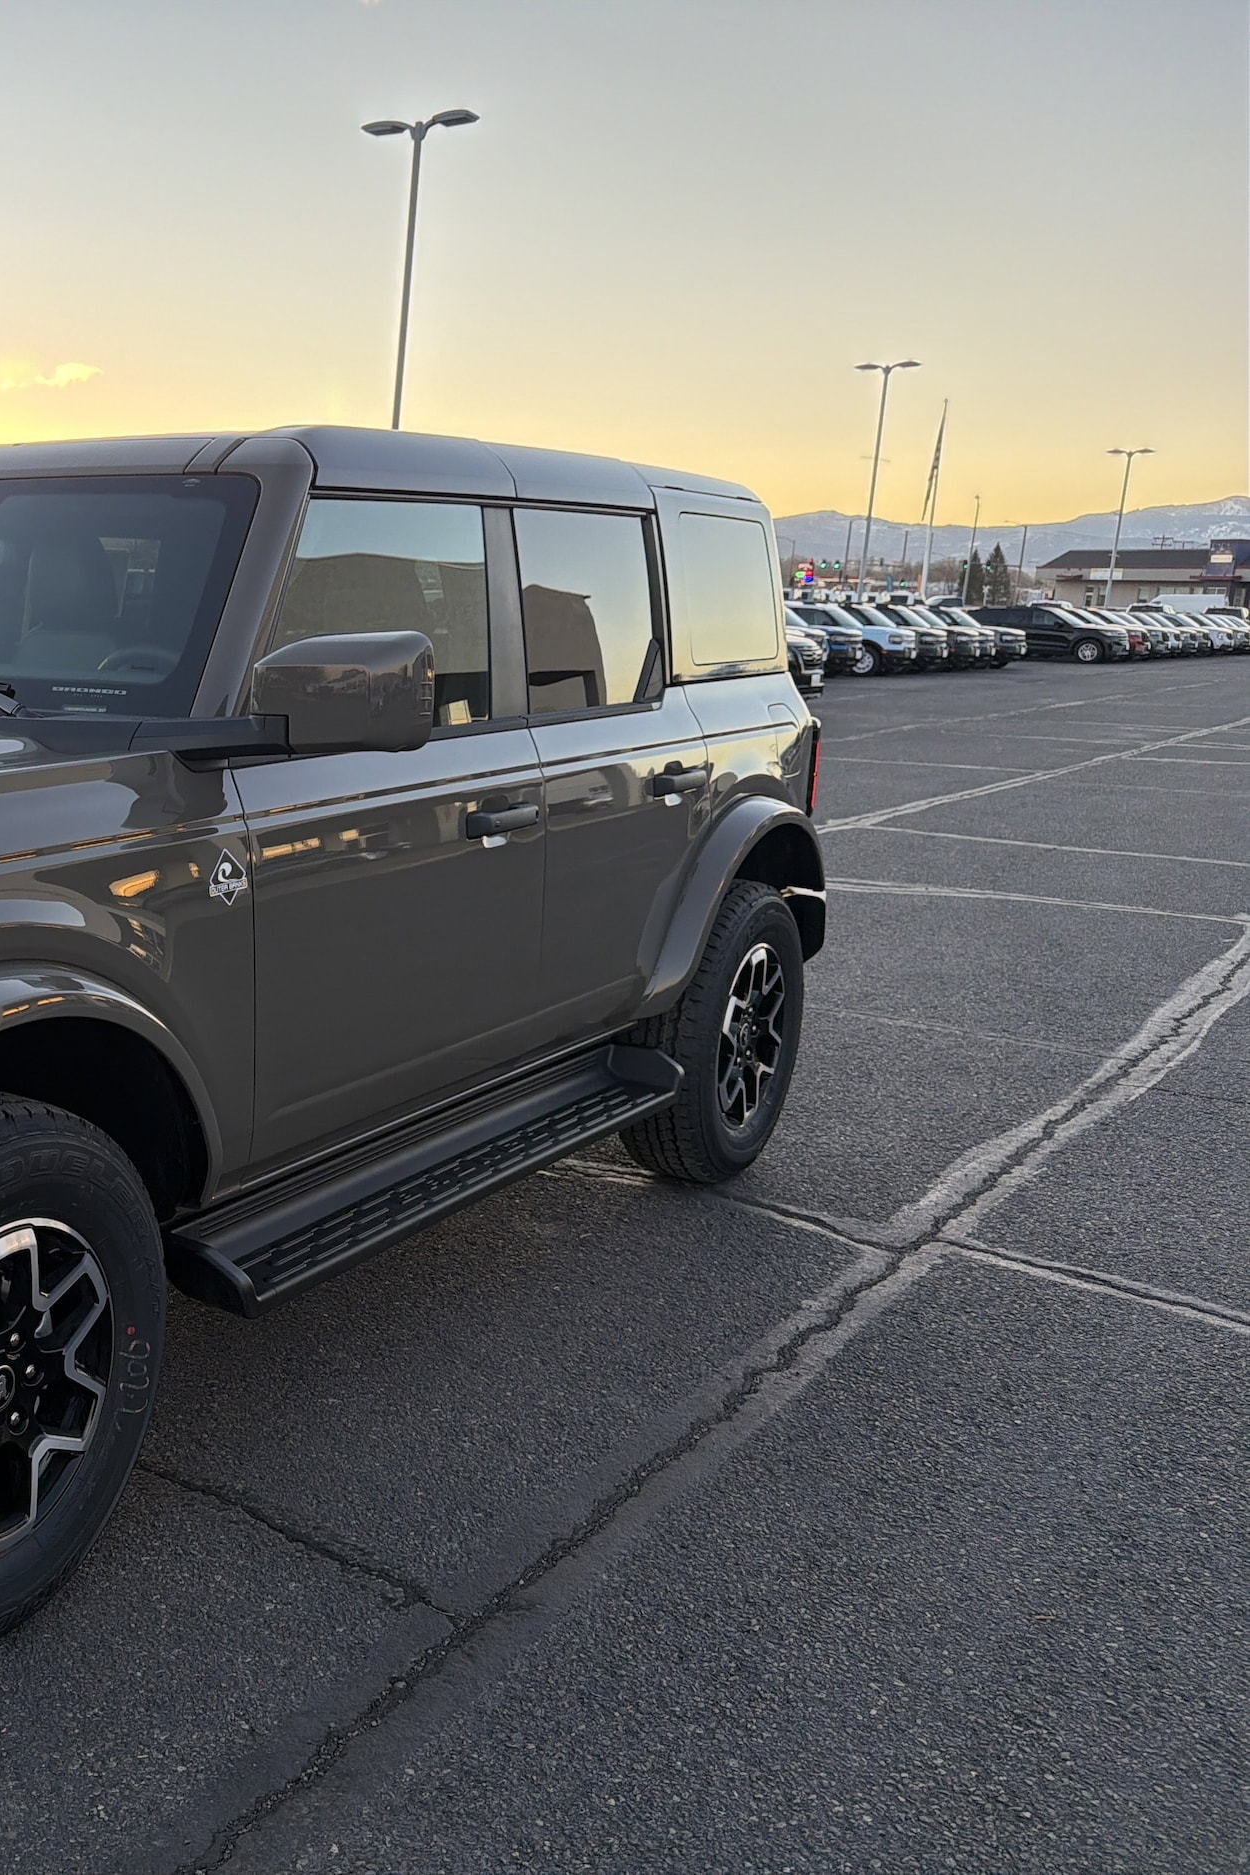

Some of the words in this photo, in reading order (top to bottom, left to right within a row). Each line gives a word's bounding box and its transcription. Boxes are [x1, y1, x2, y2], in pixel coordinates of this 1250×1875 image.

[51, 686, 128, 696] BRONCO
[211, 884, 228, 895] OUTER
[229, 879, 247, 891] BANKS
